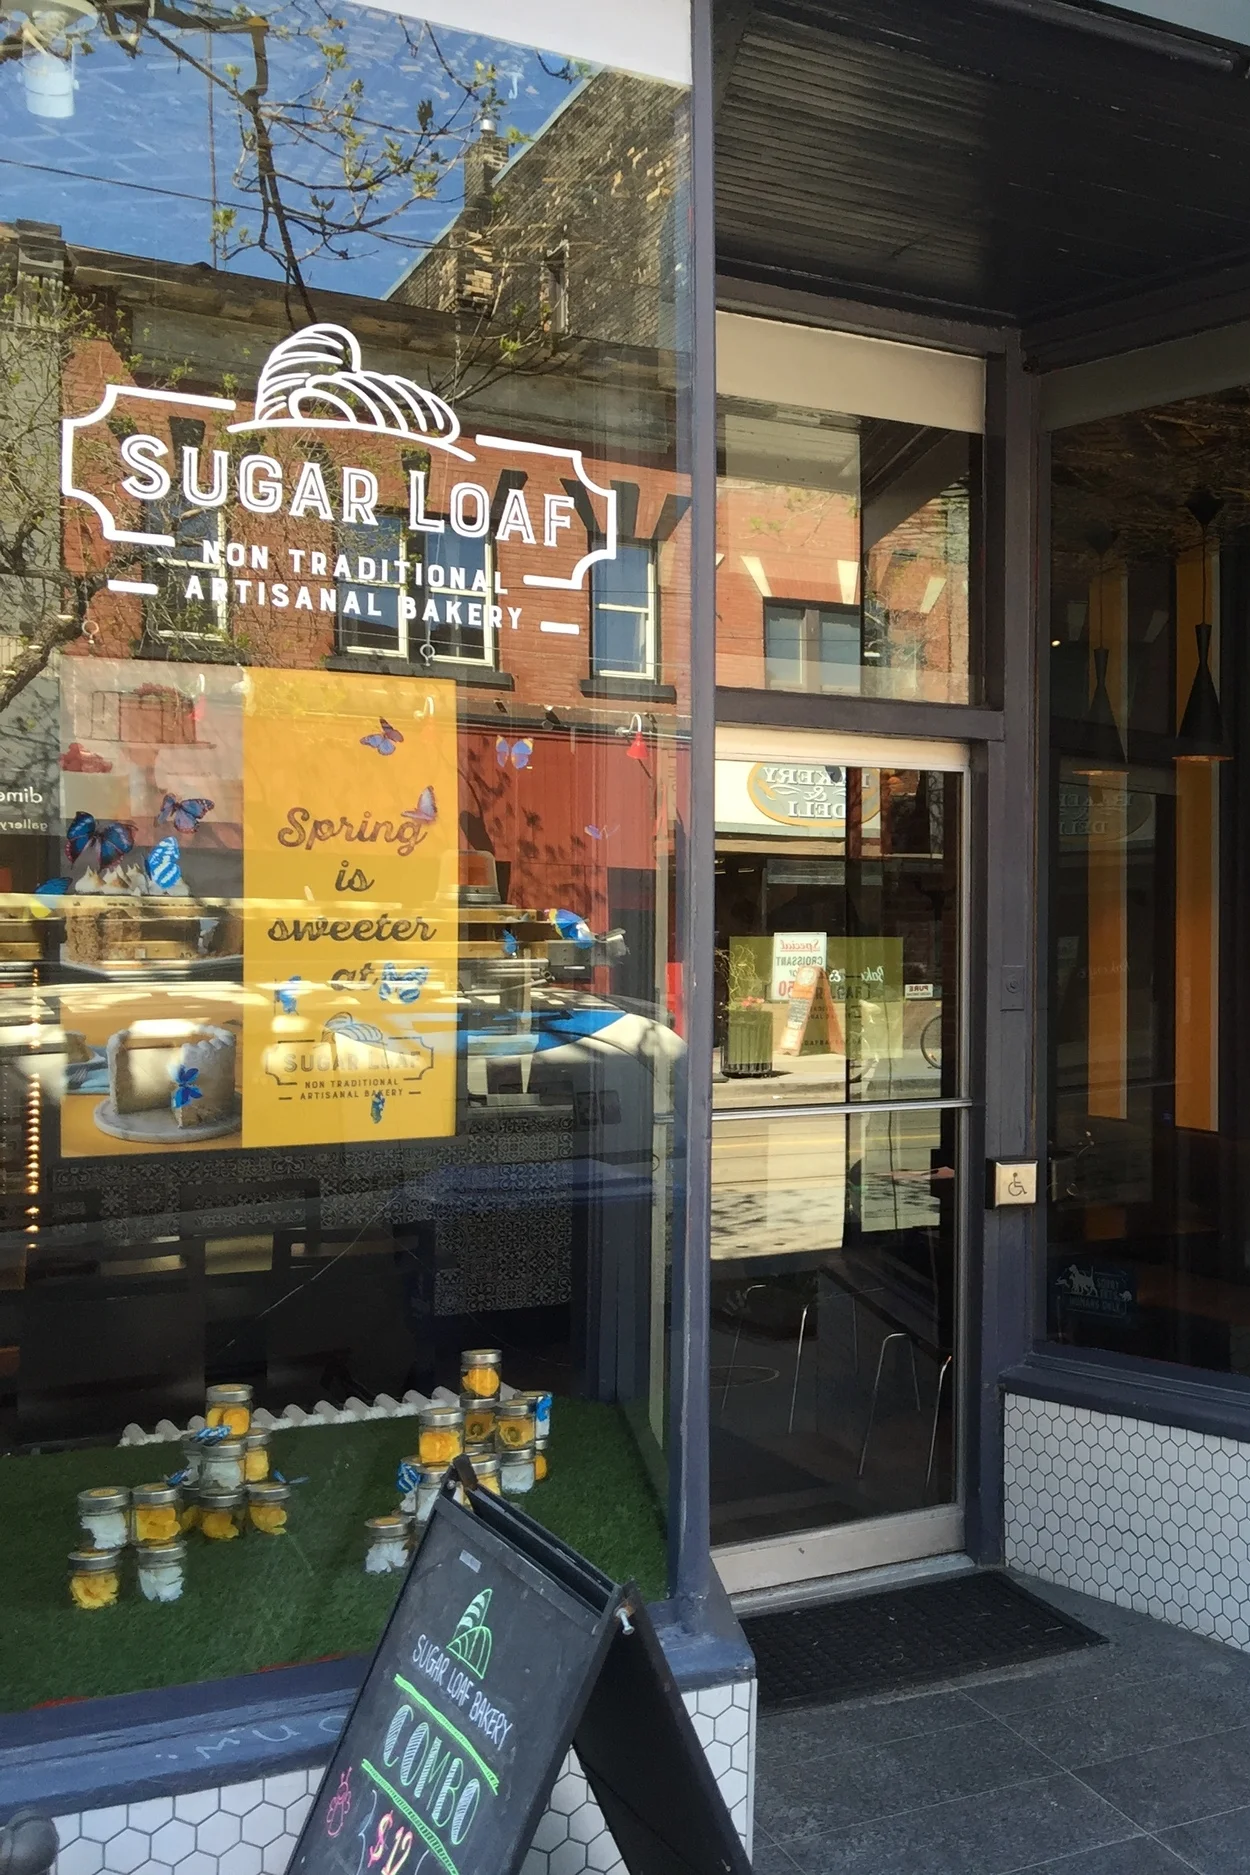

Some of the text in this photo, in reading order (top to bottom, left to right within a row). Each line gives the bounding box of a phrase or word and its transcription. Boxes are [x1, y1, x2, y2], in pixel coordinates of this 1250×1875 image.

[120, 433, 576, 548] SUGAR LOAF
[202, 539, 509, 596] NON TRADITIONAL
[184, 575, 524, 631] ARTISANAL BAKERY
[278, 807, 428, 856] Spring
[335, 860, 375, 892] is
[268, 913, 437, 941] sweeter
[331, 963, 378, 991] at
[284, 1053, 358, 1072] SUGAR
[300, 1088, 403, 1100] ARTISANAL BAKERY
[305, 1079, 399, 1089] NON TRADITIONAL
[412, 1634, 513, 1751] SUGAR LOAF BAKERY
[383, 1704, 481, 1845] COMBO
